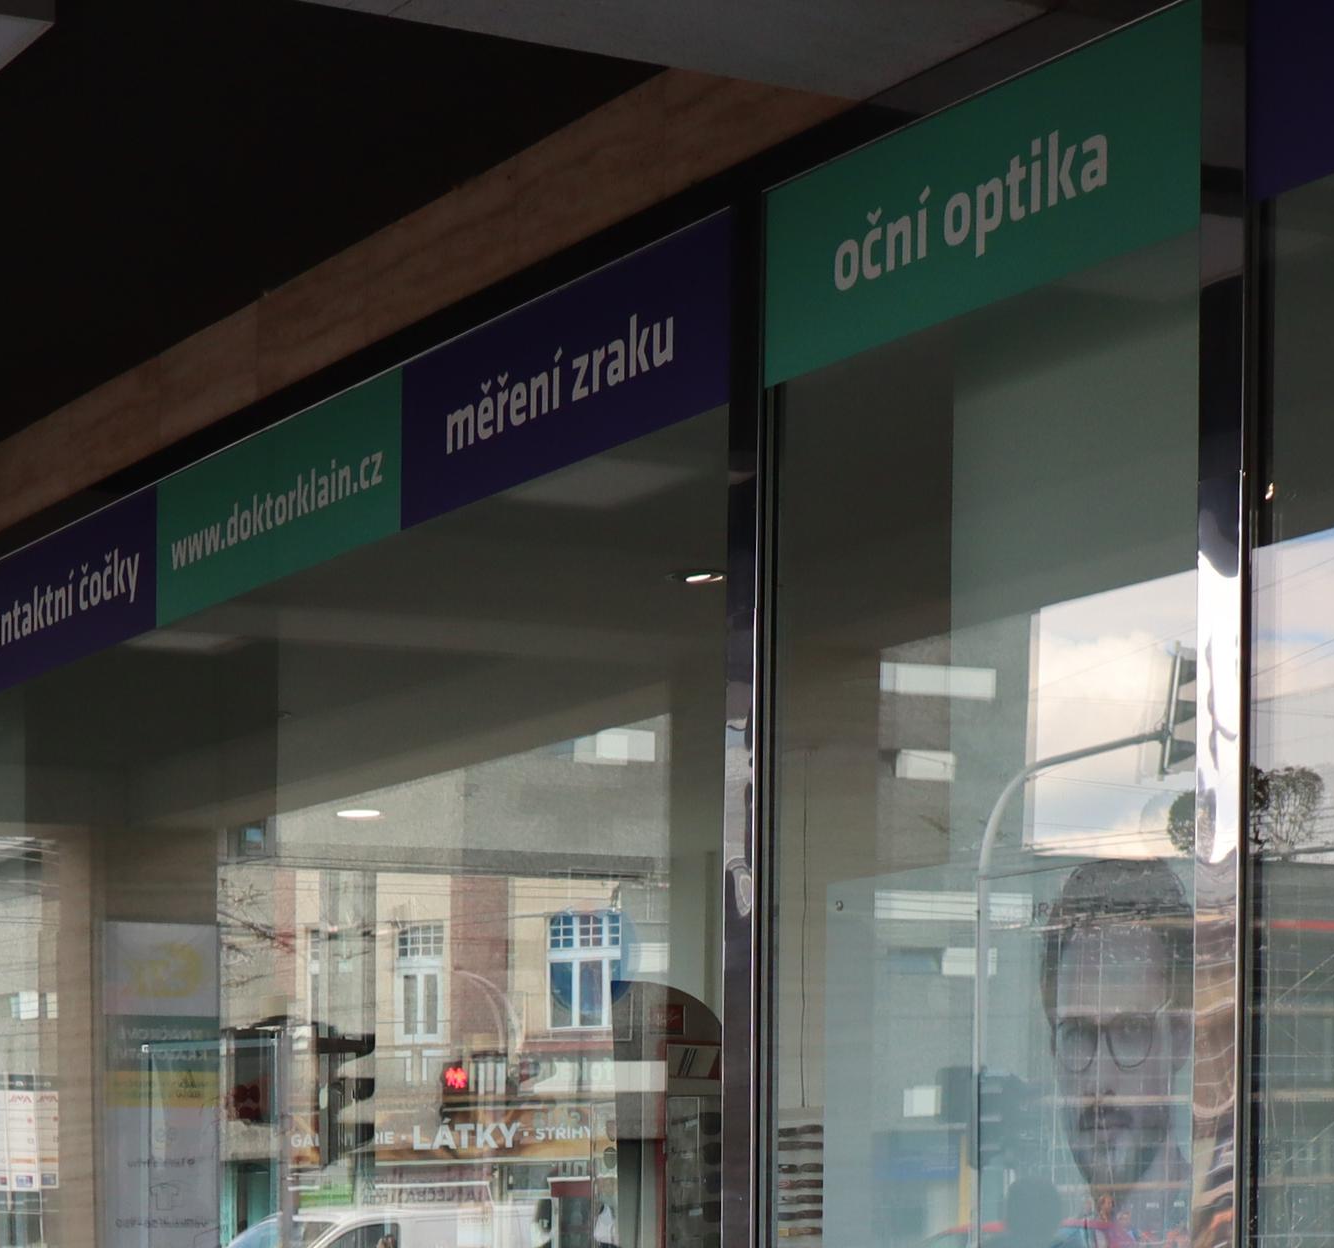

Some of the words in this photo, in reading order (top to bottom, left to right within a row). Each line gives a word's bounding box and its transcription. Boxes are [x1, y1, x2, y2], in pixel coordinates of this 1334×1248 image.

[833, 187, 930, 291] oční
[943, 129, 1108, 257] optika
[446, 348, 561, 453] měření
[571, 314, 675, 400] zraku
[170, 450, 384, 571] www.doktorklain.cz
[79, 549, 141, 613] čočky
[412, 1116, 520, 1151] LÁTKY
